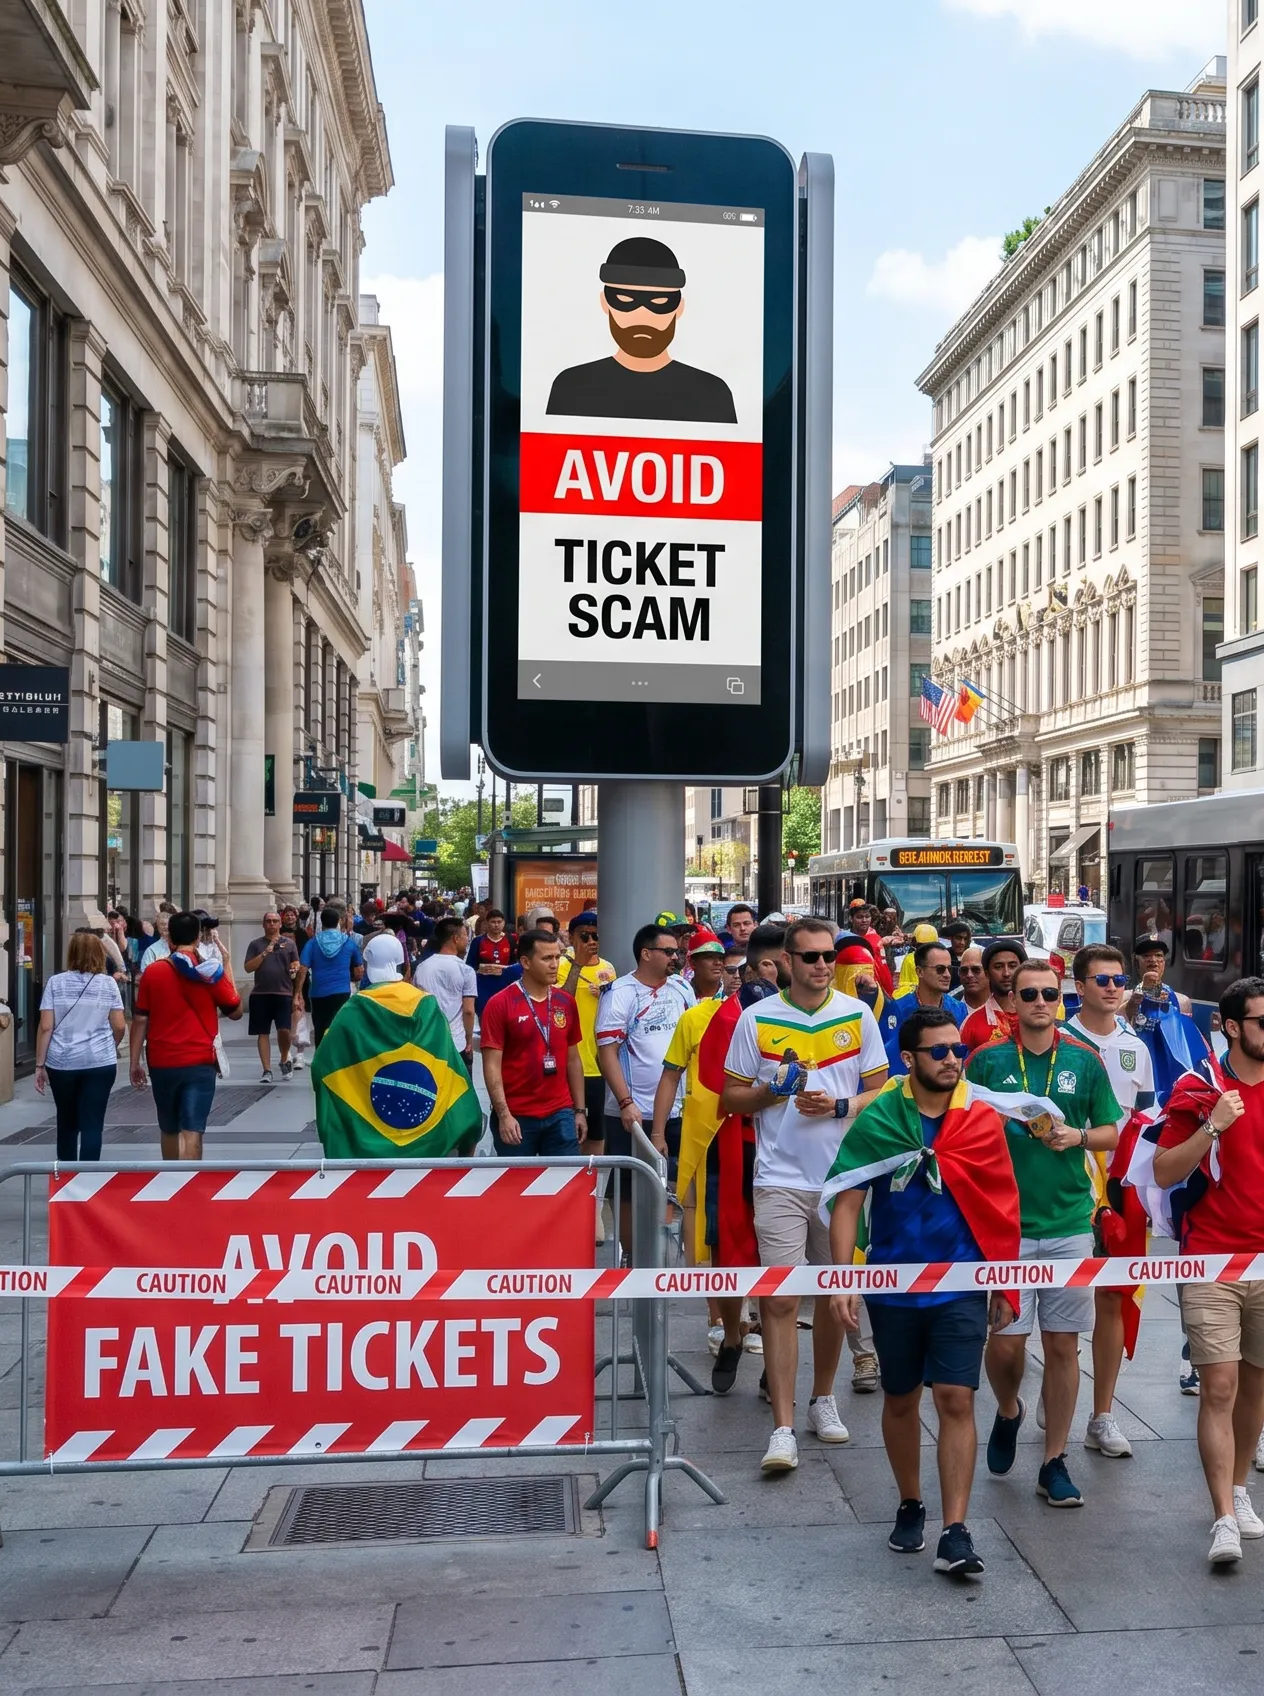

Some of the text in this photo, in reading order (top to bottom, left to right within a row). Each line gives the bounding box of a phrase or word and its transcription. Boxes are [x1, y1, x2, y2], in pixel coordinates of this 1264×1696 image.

[627, 204, 660, 215] 7:33 AM
[553, 448, 725, 505] AVOID
[554, 538, 726, 588] TICKET
[568, 593, 710, 641] SCAM
[136, 1272, 227, 1294] CAUTION
[314, 1274, 402, 1295] CAUTION
[486, 1273, 572, 1294] CAUTION
[654, 1272, 738, 1293] CAUTION
[817, 1269, 898, 1289] CAUTION
[974, 1265, 1054, 1285] CAUTION
[1128, 1259, 1205, 1280] CAUTION
[84, 1316, 561, 1398] FAKE TICKETS
